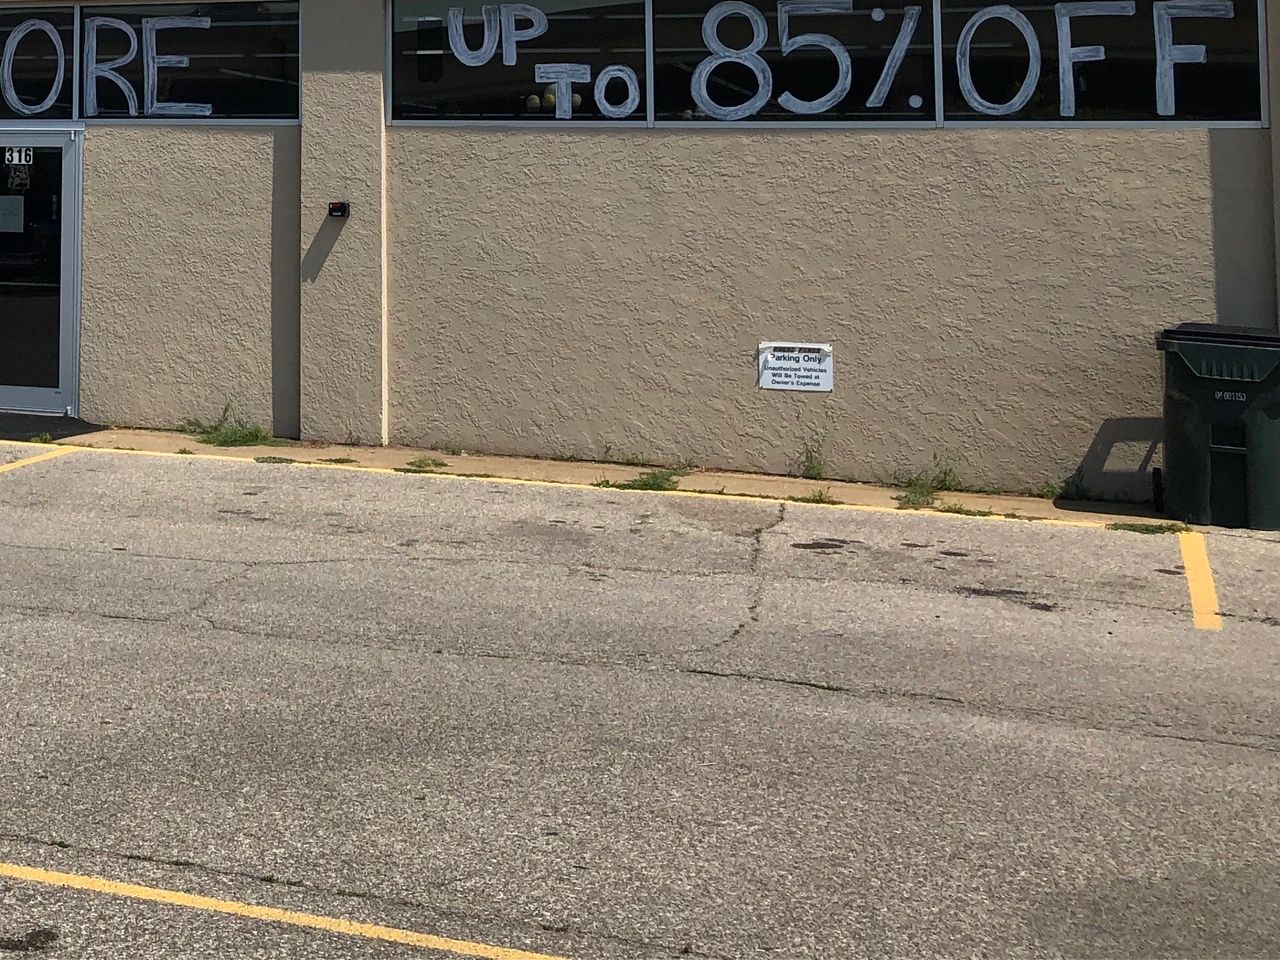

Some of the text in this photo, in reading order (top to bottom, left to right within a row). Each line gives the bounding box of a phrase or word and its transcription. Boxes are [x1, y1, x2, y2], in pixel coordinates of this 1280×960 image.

[447, 3, 549, 67] UP
[6, 147, 32, 164] 316
[802, 354, 822, 364] Only
